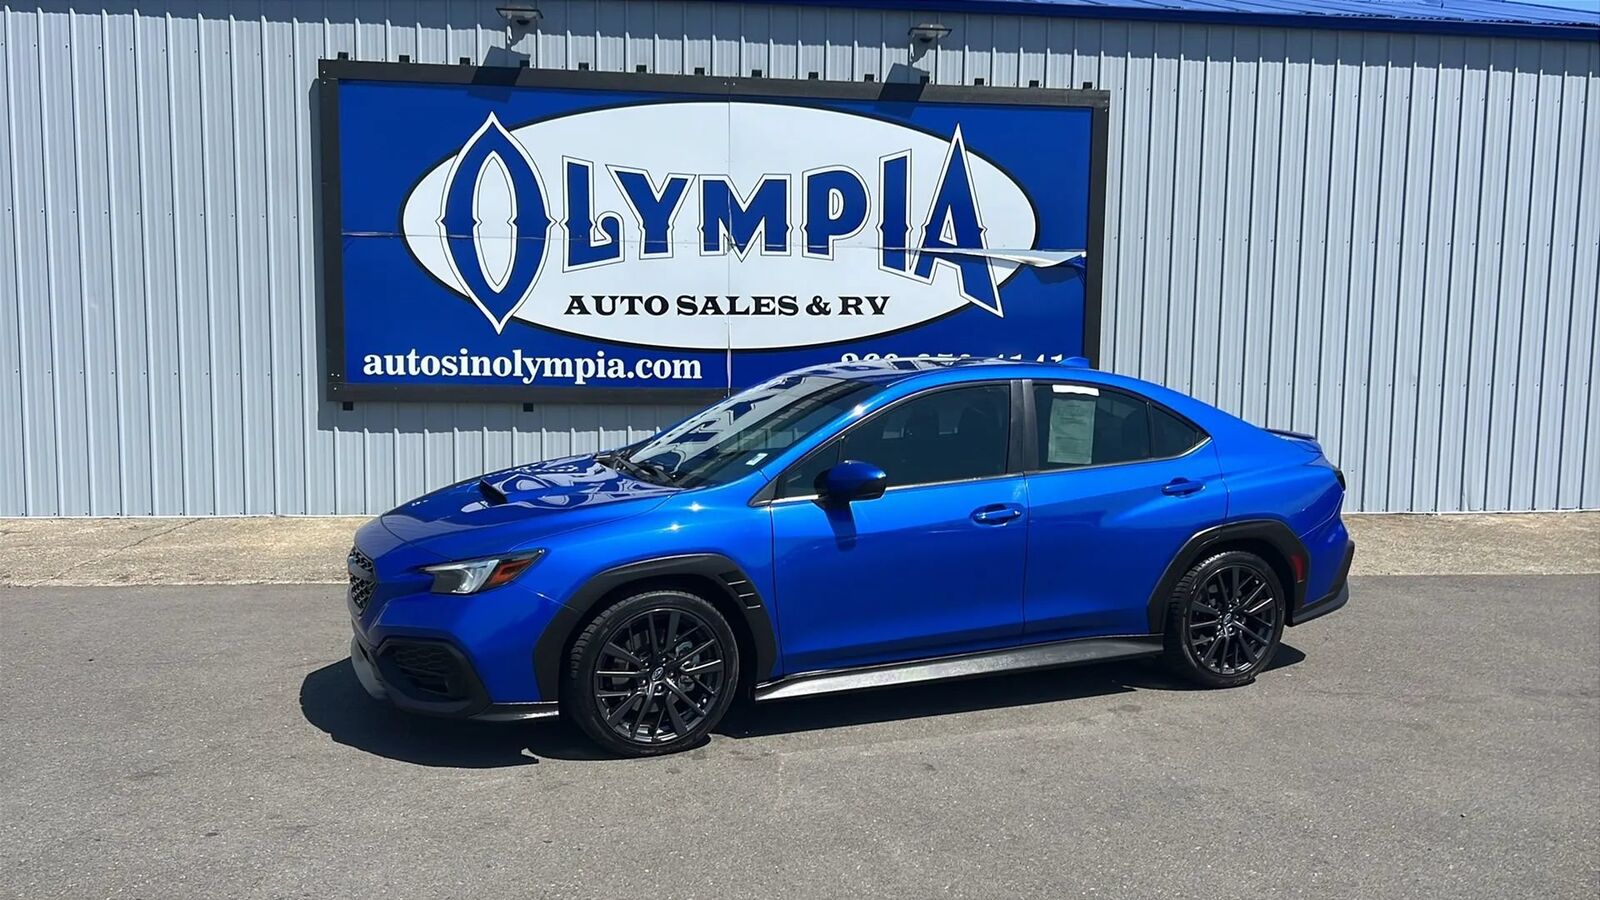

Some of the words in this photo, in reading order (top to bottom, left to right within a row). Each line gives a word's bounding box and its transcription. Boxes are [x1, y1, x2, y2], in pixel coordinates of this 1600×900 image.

[439, 113, 1003, 333] OLYMPIA
[563, 295, 670, 316] AUTO
[676, 295, 799, 316] SALES
[805, 295, 832, 316] &
[838, 296, 890, 316] RV
[363, 348, 703, 385] autosinolympia.com
